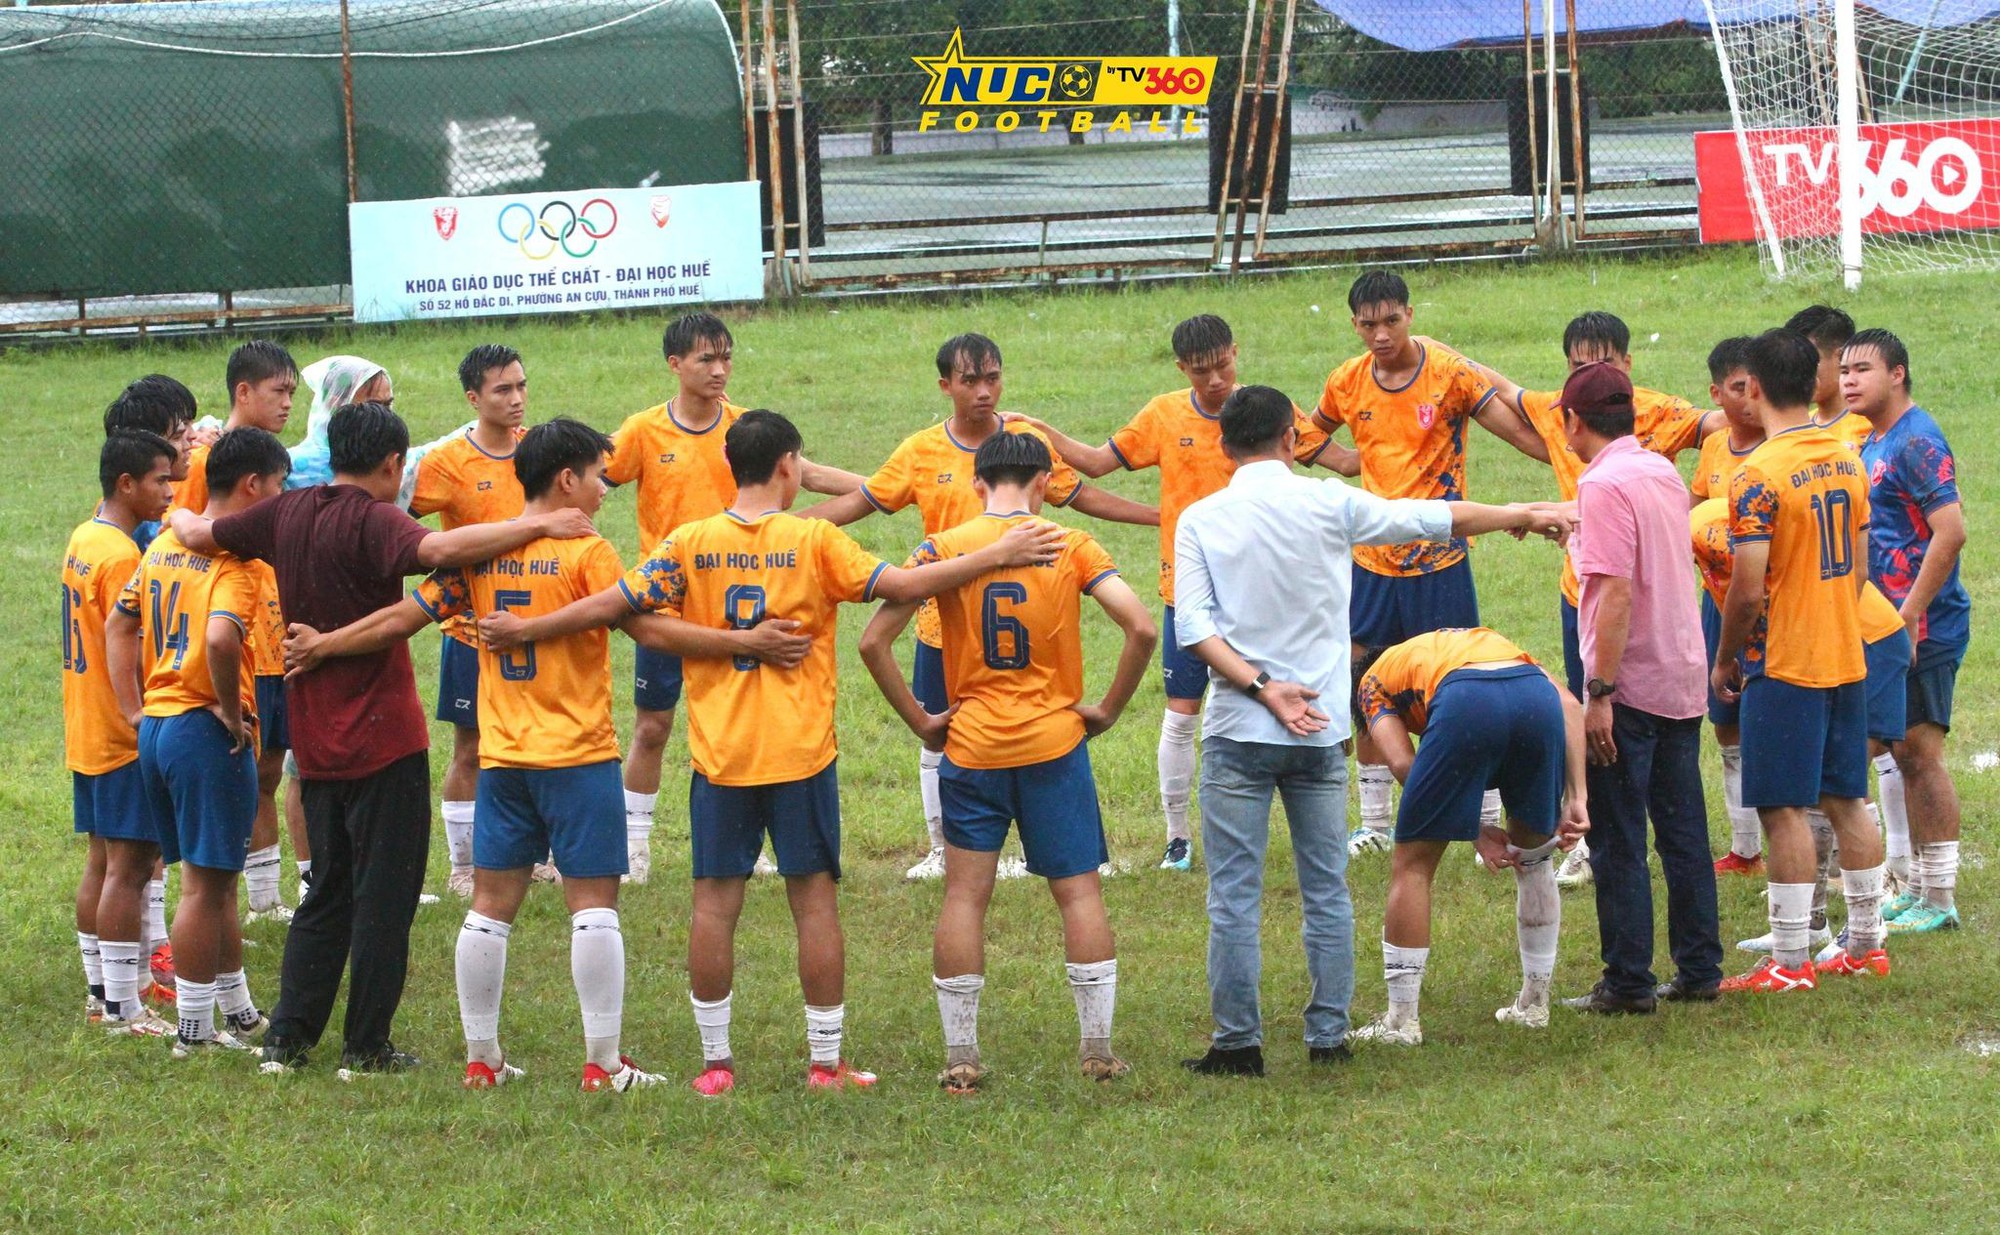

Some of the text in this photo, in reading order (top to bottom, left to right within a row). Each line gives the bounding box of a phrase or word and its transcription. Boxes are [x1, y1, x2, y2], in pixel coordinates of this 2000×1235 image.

[406, 279, 447, 293] KHOA
[452, 274, 487, 291] GIÁO
[493, 274, 524, 291] DỤC
[529, 266, 557, 287] THỂ
[562, 265, 600, 285] CHẤT
[616, 267, 641, 284] ĐẠI
[647, 265, 677, 282] HỌC
[682, 258, 711, 277] HUẾ
[438, 300, 451, 310] 52
[566, 292, 582, 303] AN
[1811, 488, 1853, 580] 10
[497, 559, 524, 578] HỌC
[530, 556, 559, 575] HUẾ
[695, 547, 797, 573] ĐẠI HỌC HUẾ
[150, 579, 189, 670] 14
[982, 582, 1030, 669] 6
